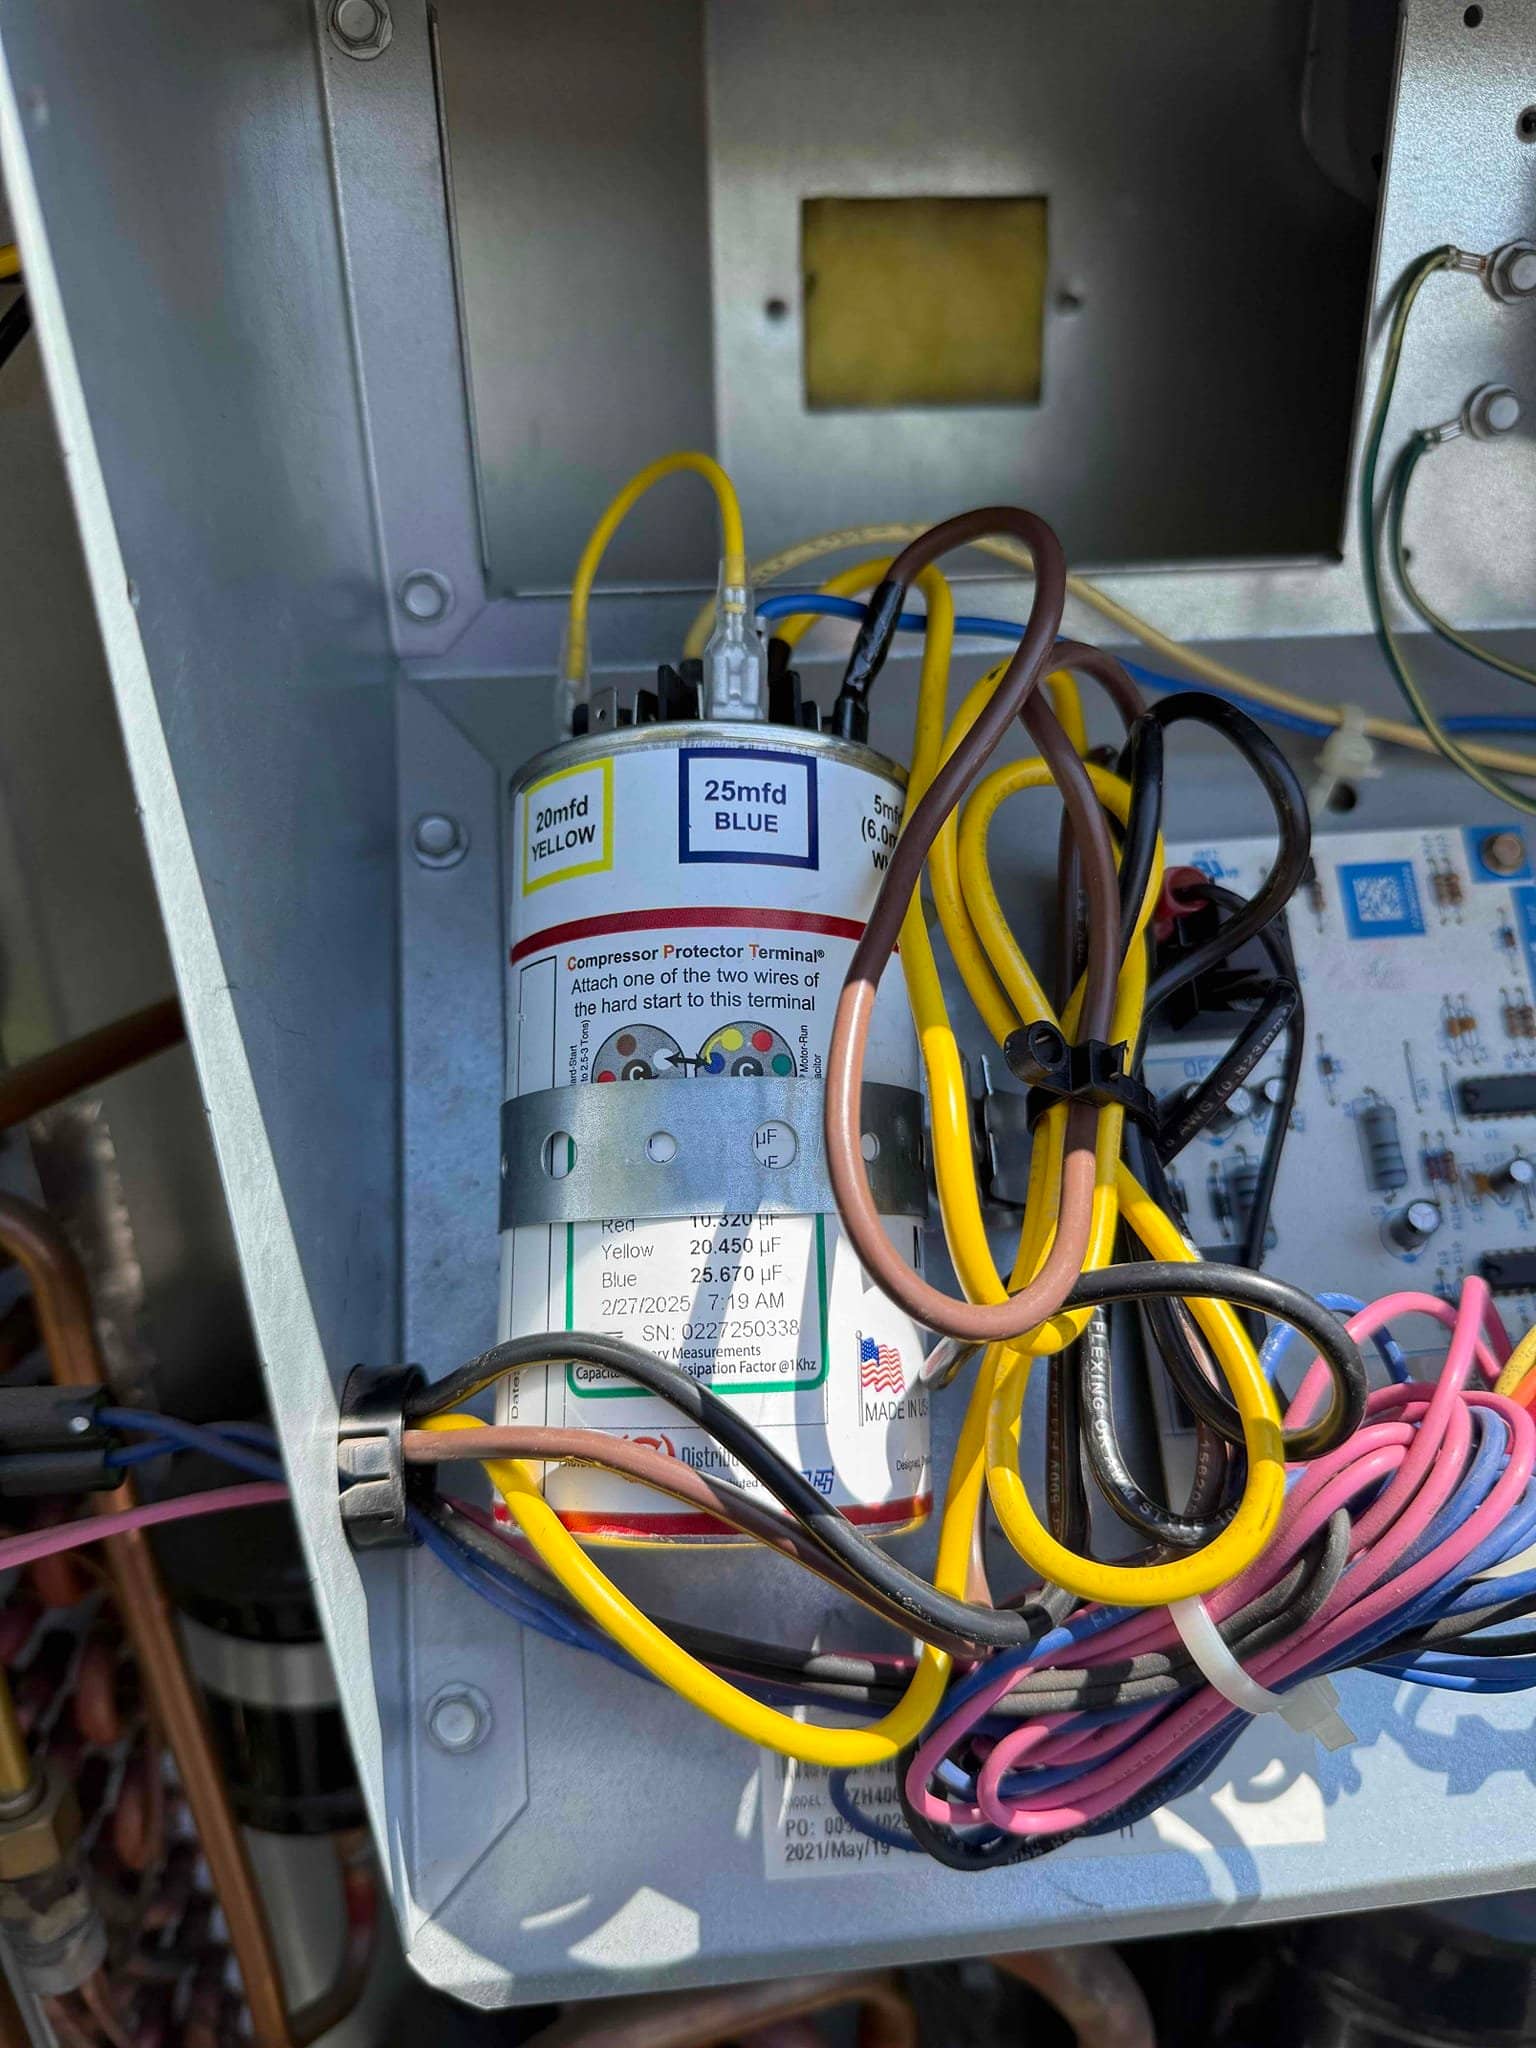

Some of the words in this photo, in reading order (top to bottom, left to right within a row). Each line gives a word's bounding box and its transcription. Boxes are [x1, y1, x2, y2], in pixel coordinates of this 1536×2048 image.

[704, 780, 786, 805] 25mfd
[536, 795, 588, 834] 20mfd
[715, 811, 778, 833] BLUE
[532, 824, 595, 862] YELLOW
[567, 948, 659, 971] Compressor
[663, 944, 744, 959] Protector
[571, 973, 618, 995] Attach
[623, 973, 655, 988] one
[660, 967, 678, 984] of
[683, 967, 711, 983] the
[717, 967, 748, 983] two
[754, 968, 799, 986] wires
[804, 971, 820, 988] of
[574, 1001, 597, 1018] the
[601, 994, 637, 1014] hard
[643, 991, 682, 1010] start
[687, 991, 705, 1008] to
[710, 991, 742, 1007] this
[748, 992, 815, 1012] terminal
[580, 1019, 591, 1046] Tons)
[580, 1047, 589, 1071] 2.5-3
[799, 1025, 809, 1073] Motor-Run
[568, 1044, 577, 1087] ard-Start
[814, 1053, 823, 1080] acitor
[601, 1218, 635, 1234] Red
[690, 1214, 753, 1229] 10.320
[601, 1244, 655, 1261] Yellow
[690, 1238, 753, 1256] 20.450
[602, 1272, 638, 1289] Blue
[690, 1265, 754, 1283] 25.670
[601, 1295, 691, 1316] 2/27/2025
[708, 1292, 749, 1311] 7:19
[755, 1291, 785, 1309] AM
[642, 1324, 676, 1342] SN:
[681, 1319, 801, 1341] 0227250338
[672, 1345, 762, 1360] Measurements
[740, 1359, 777, 1374] Factor
[1090, 1320, 1107, 1411] FLEXING
[864, 1399, 905, 1422] MADE
[907, 1399, 917, 1418] IN
[785, 1819, 816, 1837] PO:
[785, 1837, 891, 1861] 2021/May/19
